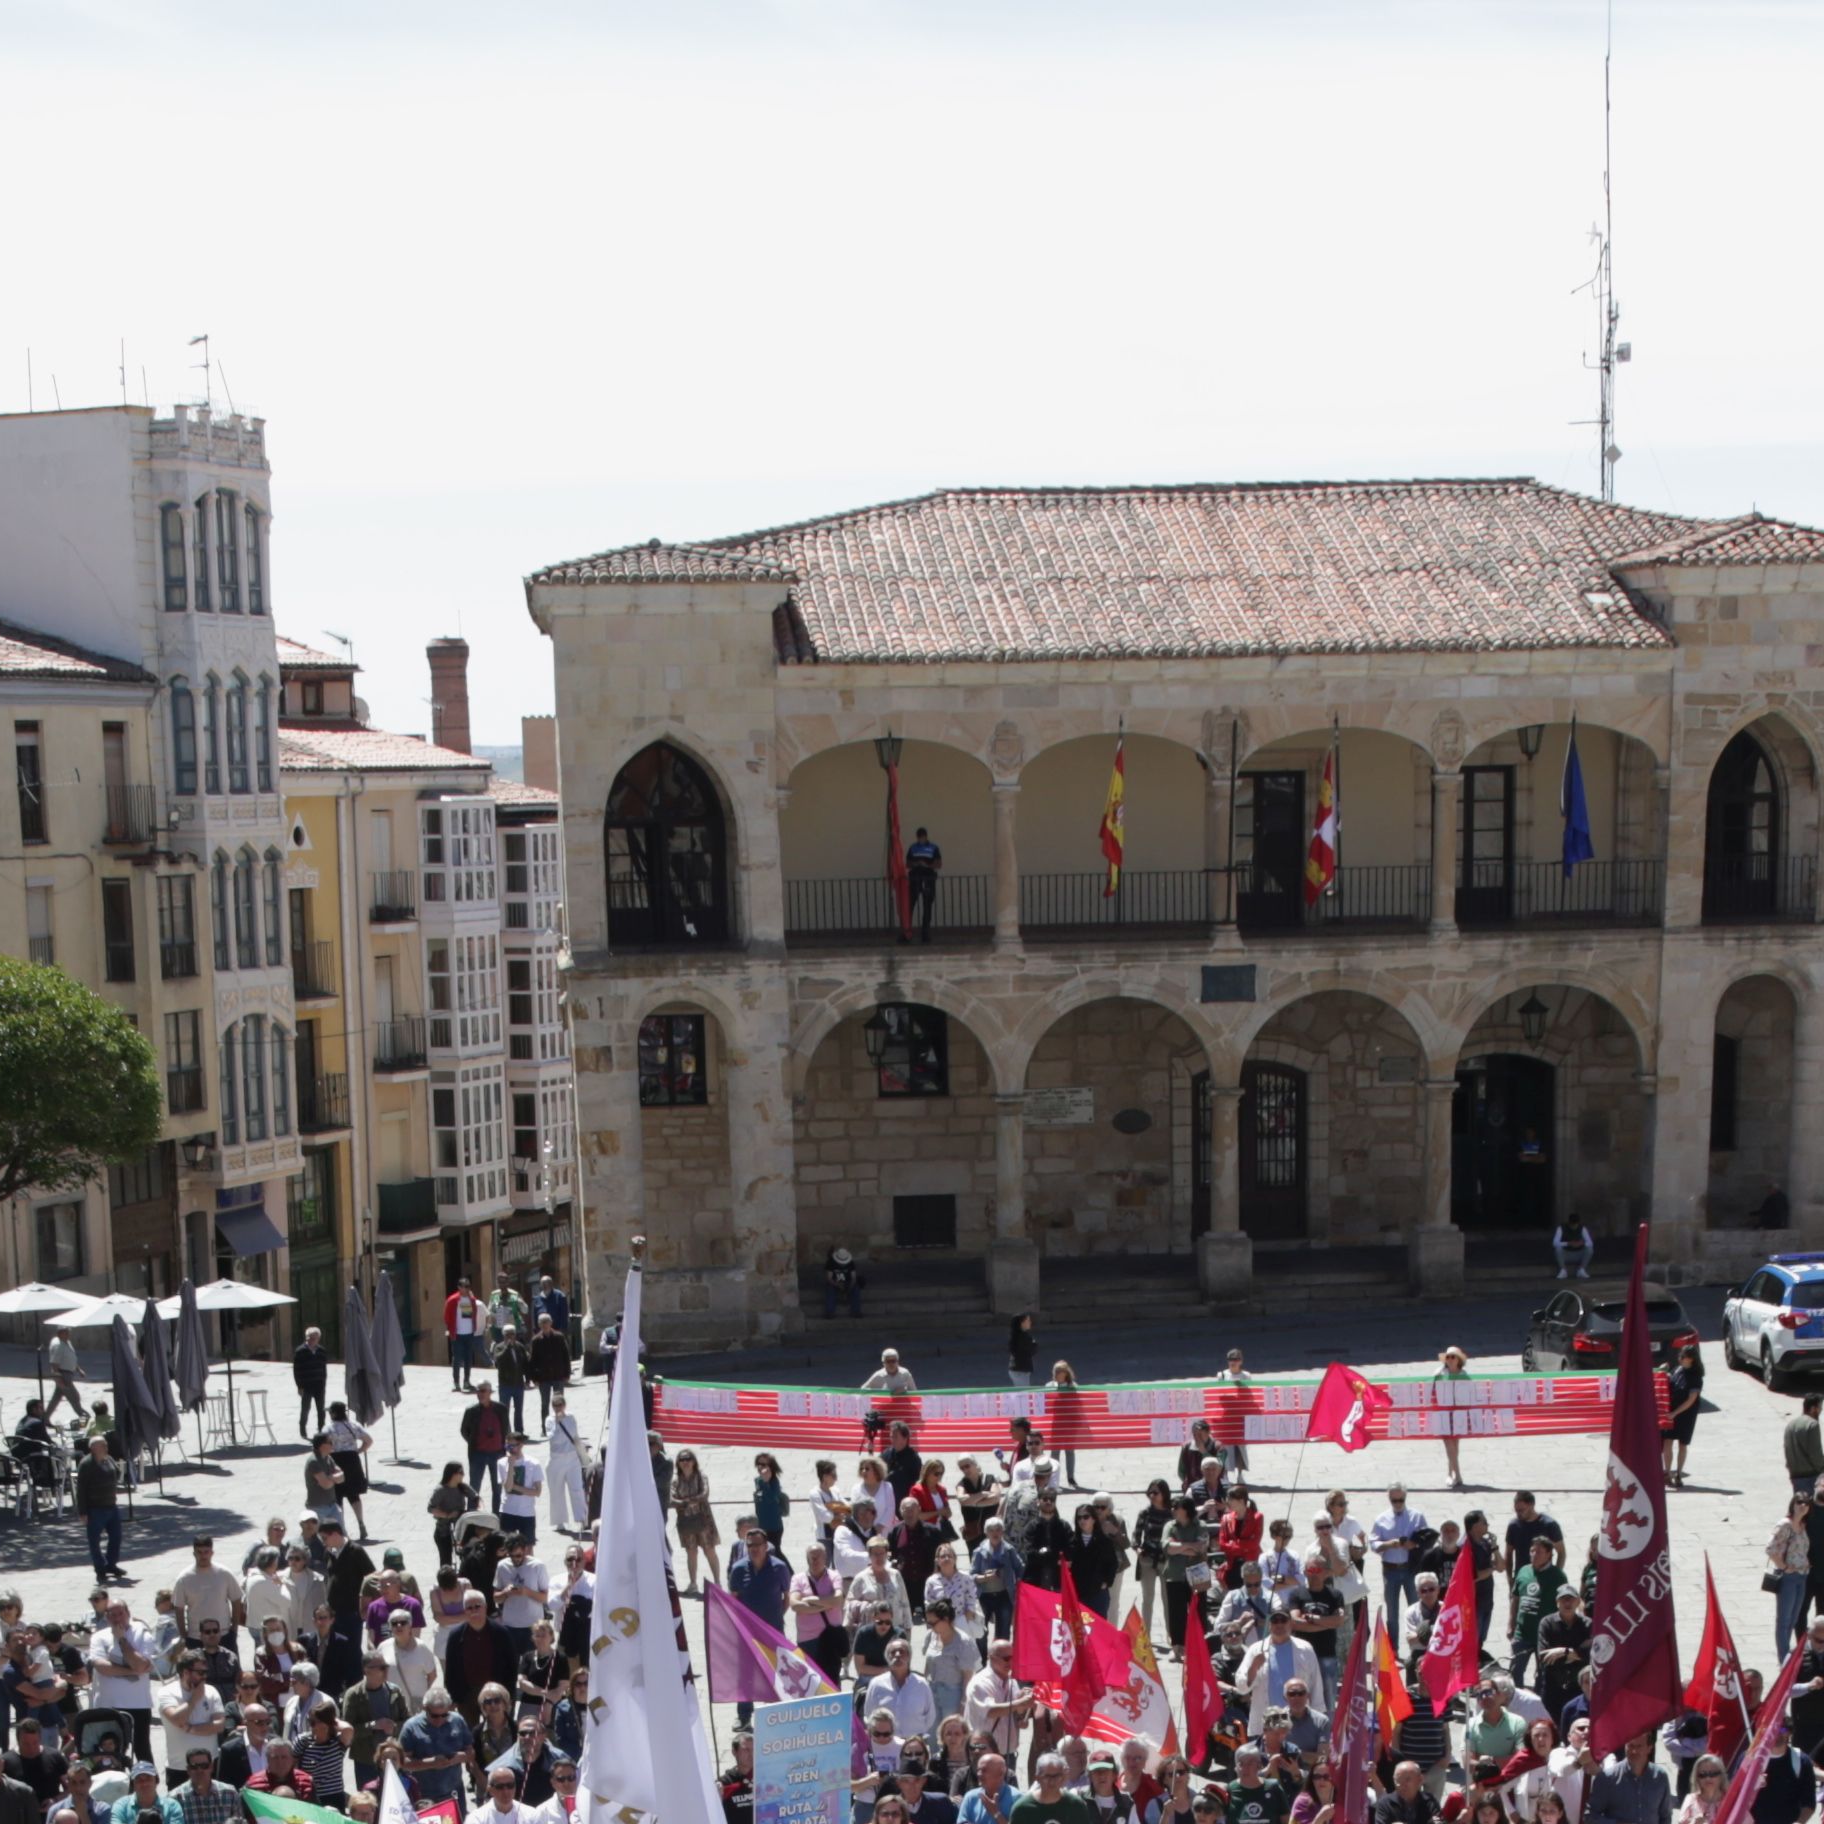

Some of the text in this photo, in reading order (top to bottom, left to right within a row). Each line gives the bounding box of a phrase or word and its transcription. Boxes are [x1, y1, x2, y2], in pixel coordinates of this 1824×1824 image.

[766, 1702, 842, 1726] GUIJUELO
[762, 1730, 845, 1755] SORIHUELA
[787, 1770, 819, 1785] TREN
[779, 1801, 812, 1818] RUTA
